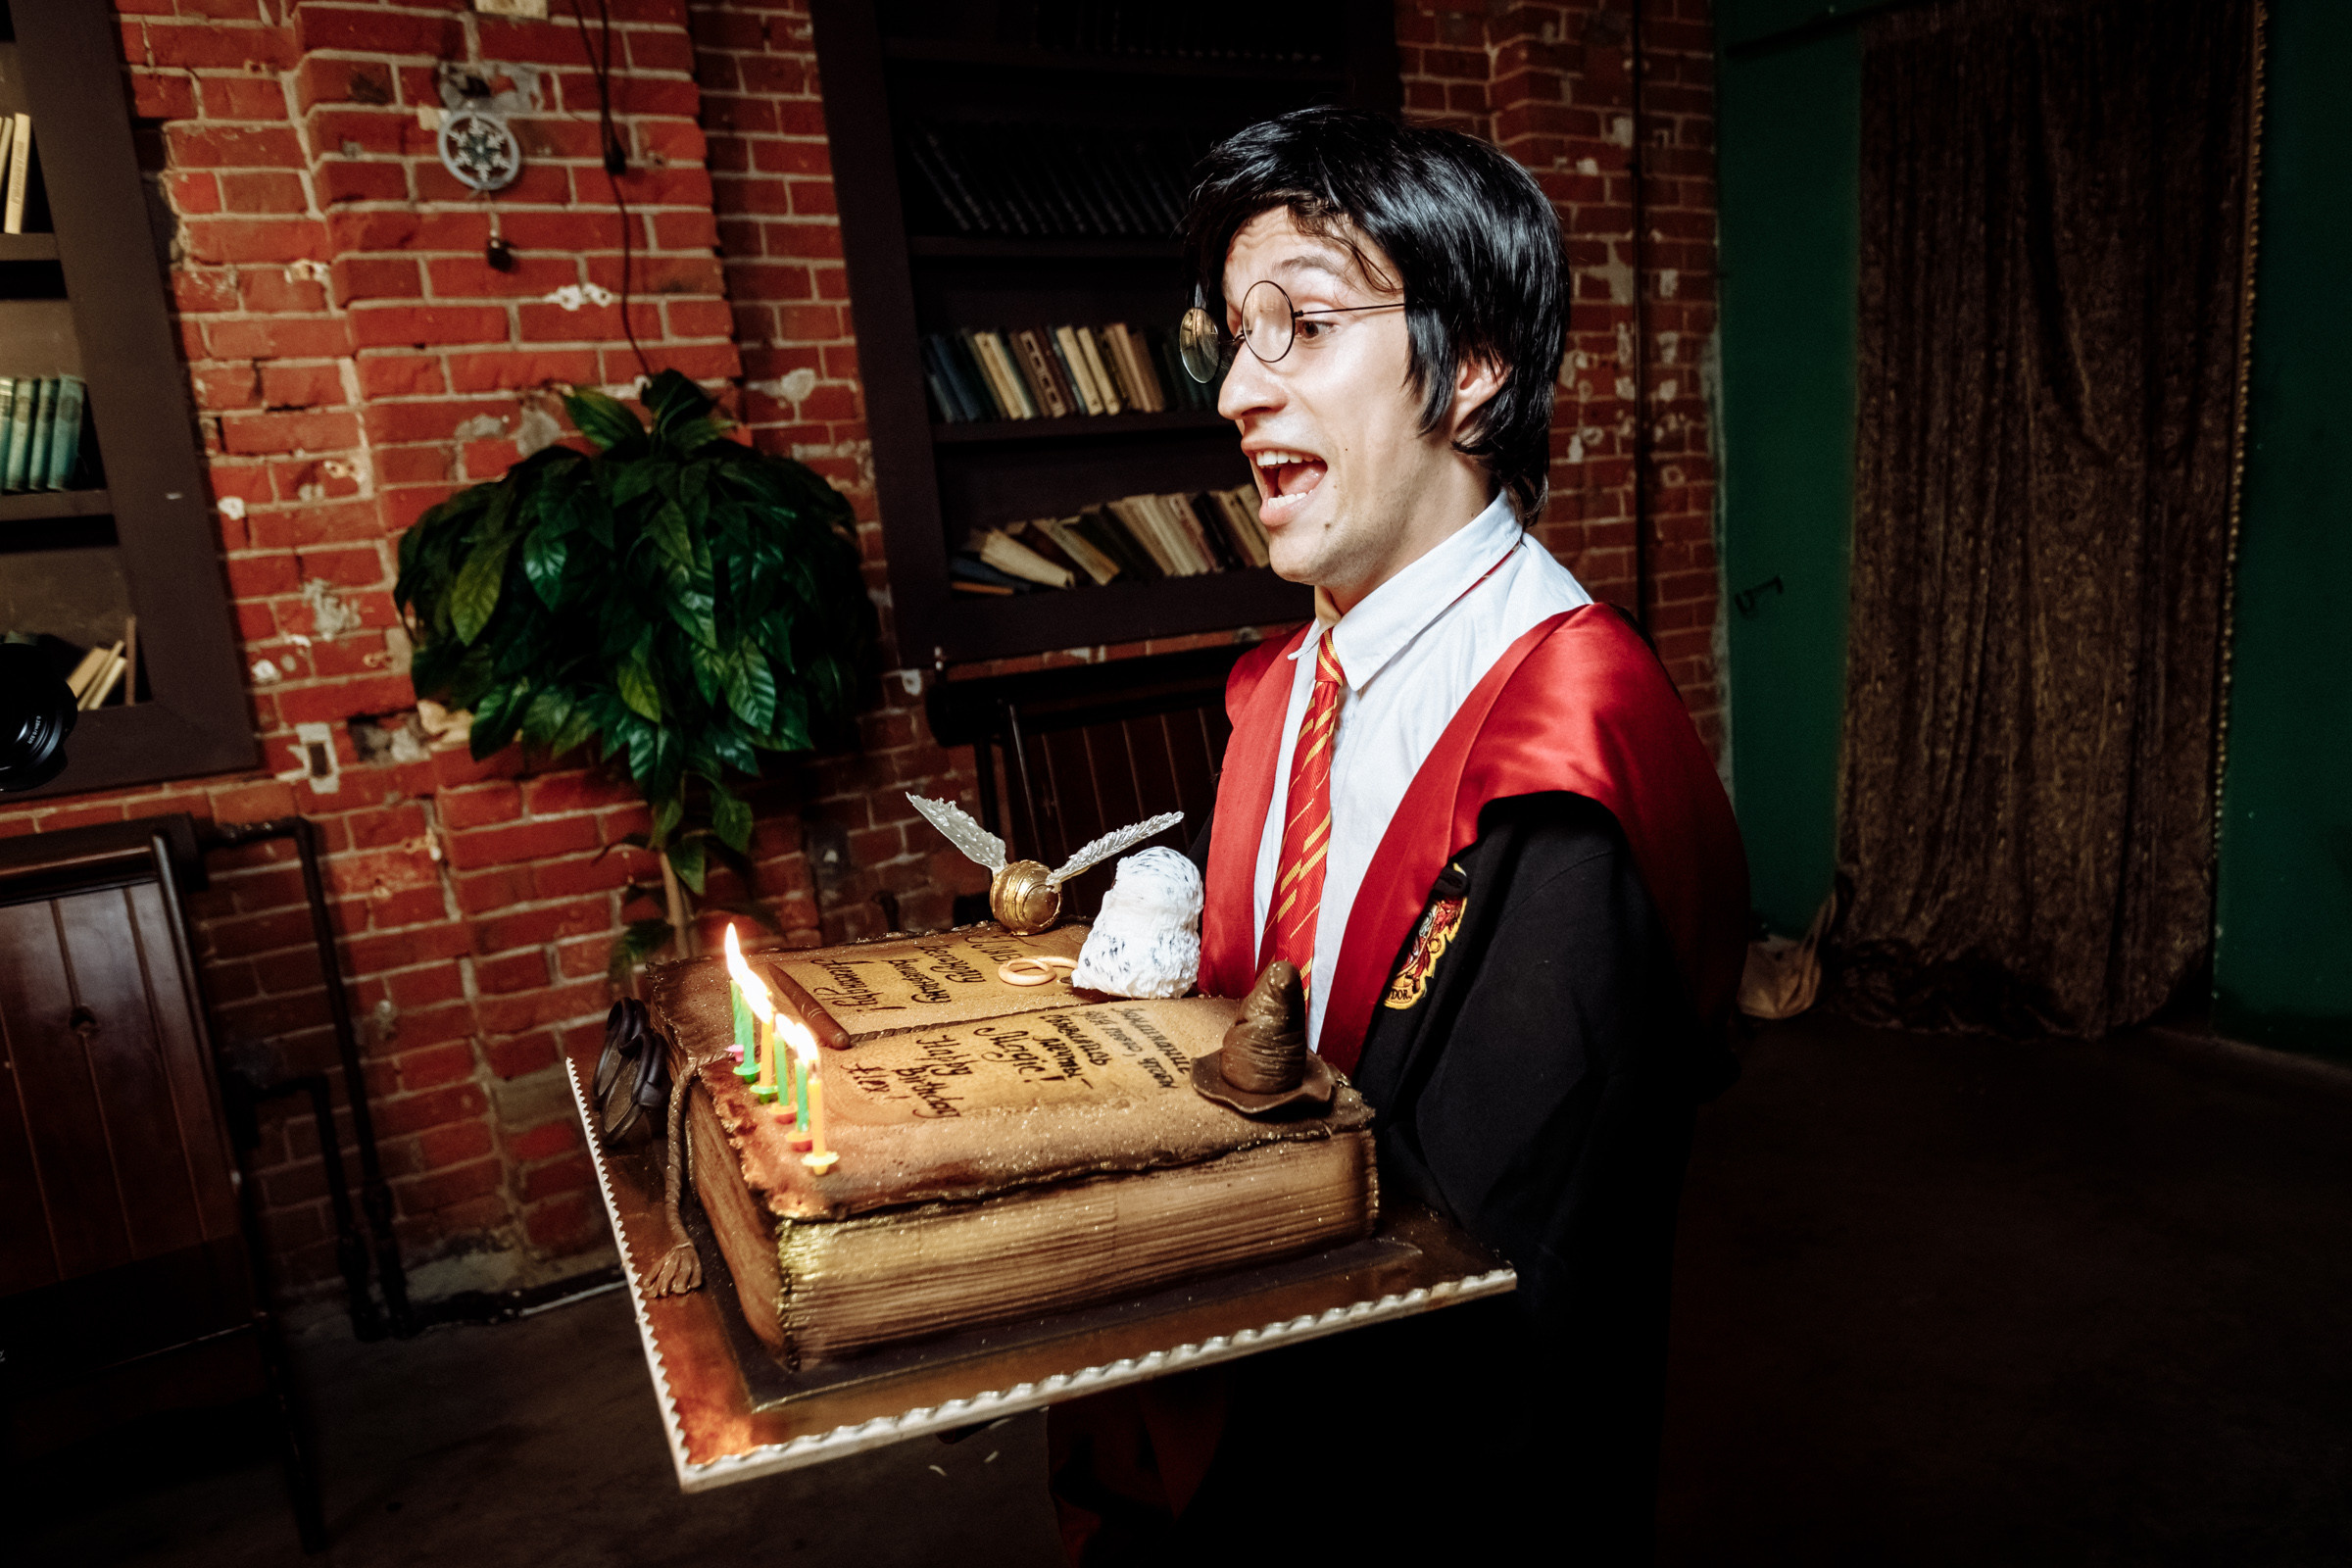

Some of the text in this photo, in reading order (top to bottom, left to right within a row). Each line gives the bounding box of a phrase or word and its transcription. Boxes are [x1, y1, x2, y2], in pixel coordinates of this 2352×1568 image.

[810, 958, 907, 1012] Александру!
[840, 1062, 911, 1101] Alex!
[914, 1034, 979, 1076] Happy
[973, 1027, 1066, 1083] Magic!
[891, 1065, 964, 1118] Birthday
